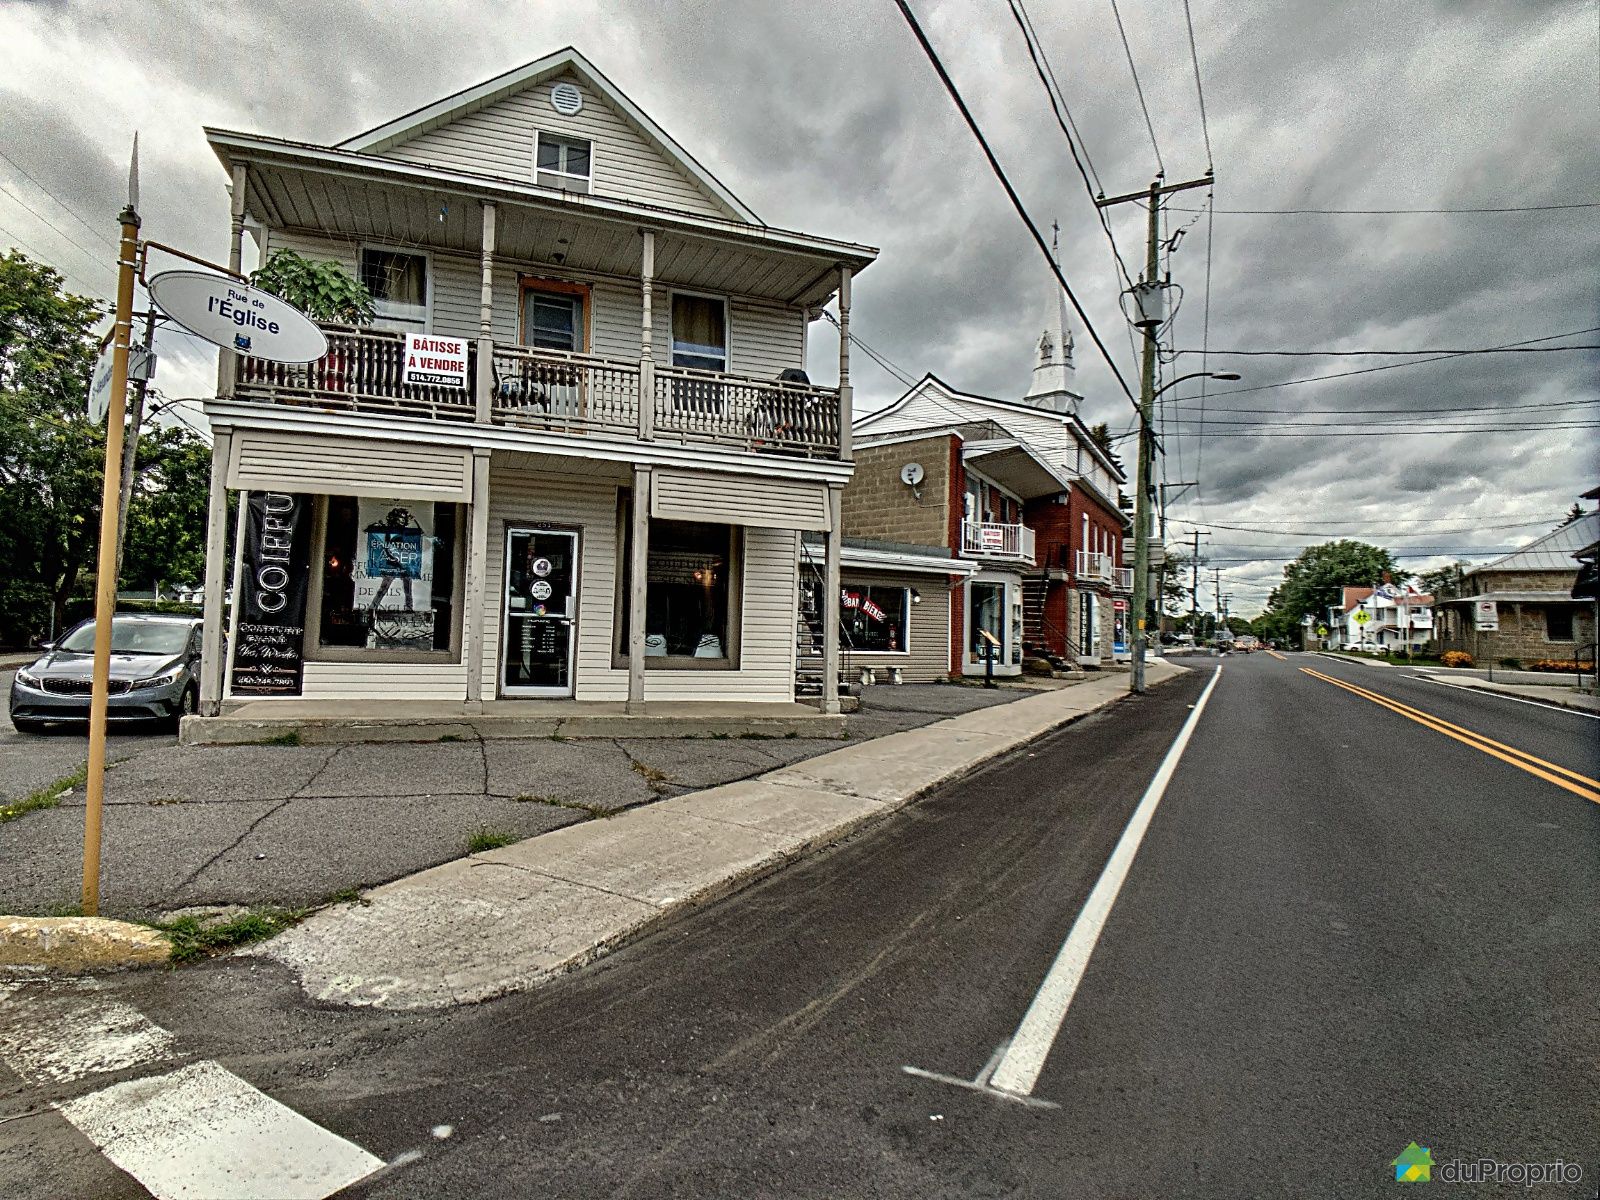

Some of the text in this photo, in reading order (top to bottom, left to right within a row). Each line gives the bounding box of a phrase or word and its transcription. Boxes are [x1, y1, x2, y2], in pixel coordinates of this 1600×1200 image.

[228, 289, 265, 309] Rue de
[208, 296, 280, 334] l'Église
[413, 338, 461, 354] BÂTISSE
[408, 354, 465, 372] À VENDRE
